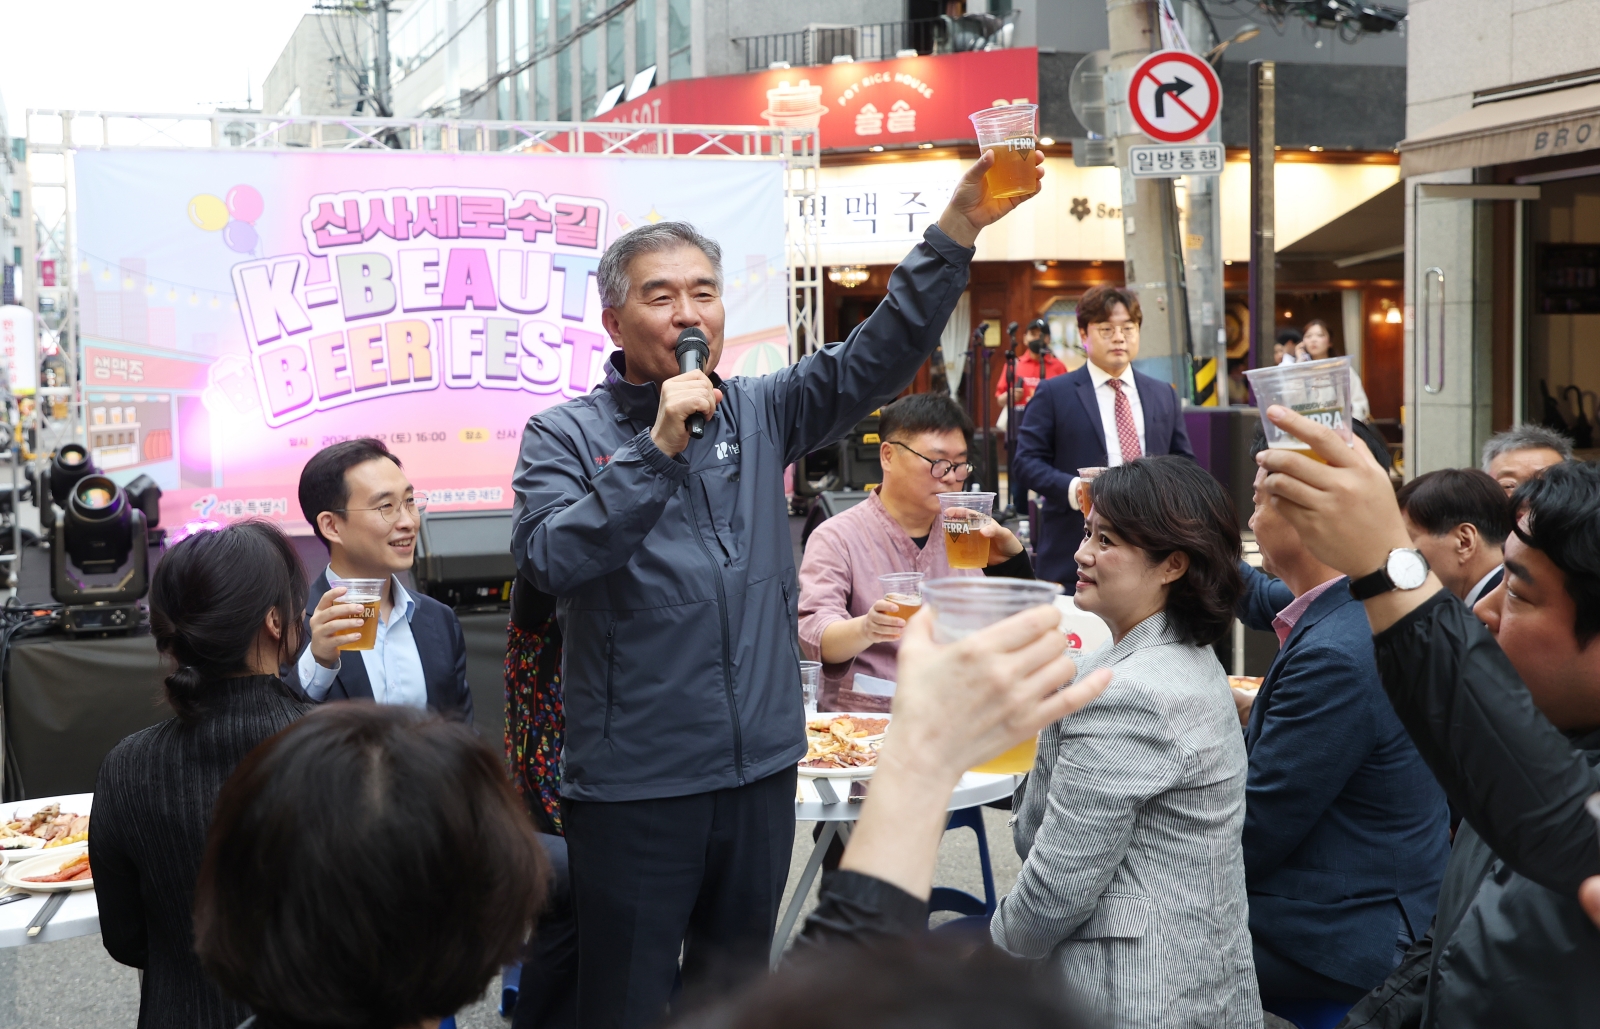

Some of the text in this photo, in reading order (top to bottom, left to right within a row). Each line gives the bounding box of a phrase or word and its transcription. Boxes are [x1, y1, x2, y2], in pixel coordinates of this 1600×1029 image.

[837, 83, 860, 107] POT
[894, 72, 935, 99] HOUSE
[1533, 123, 1600, 151] BRO
[1137, 150, 1217, 172] 일방통행
[310, 194, 601, 248] 신사세로수길
[239, 248, 601, 346] K-BEAUT
[94, 355, 145, 383] 생맥주
[258, 316, 605, 419] BEER FEST
[416, 431, 447, 443] 16:00
[217, 499, 286, 516] 서울특별시
[943, 521, 971, 535] TERRA
